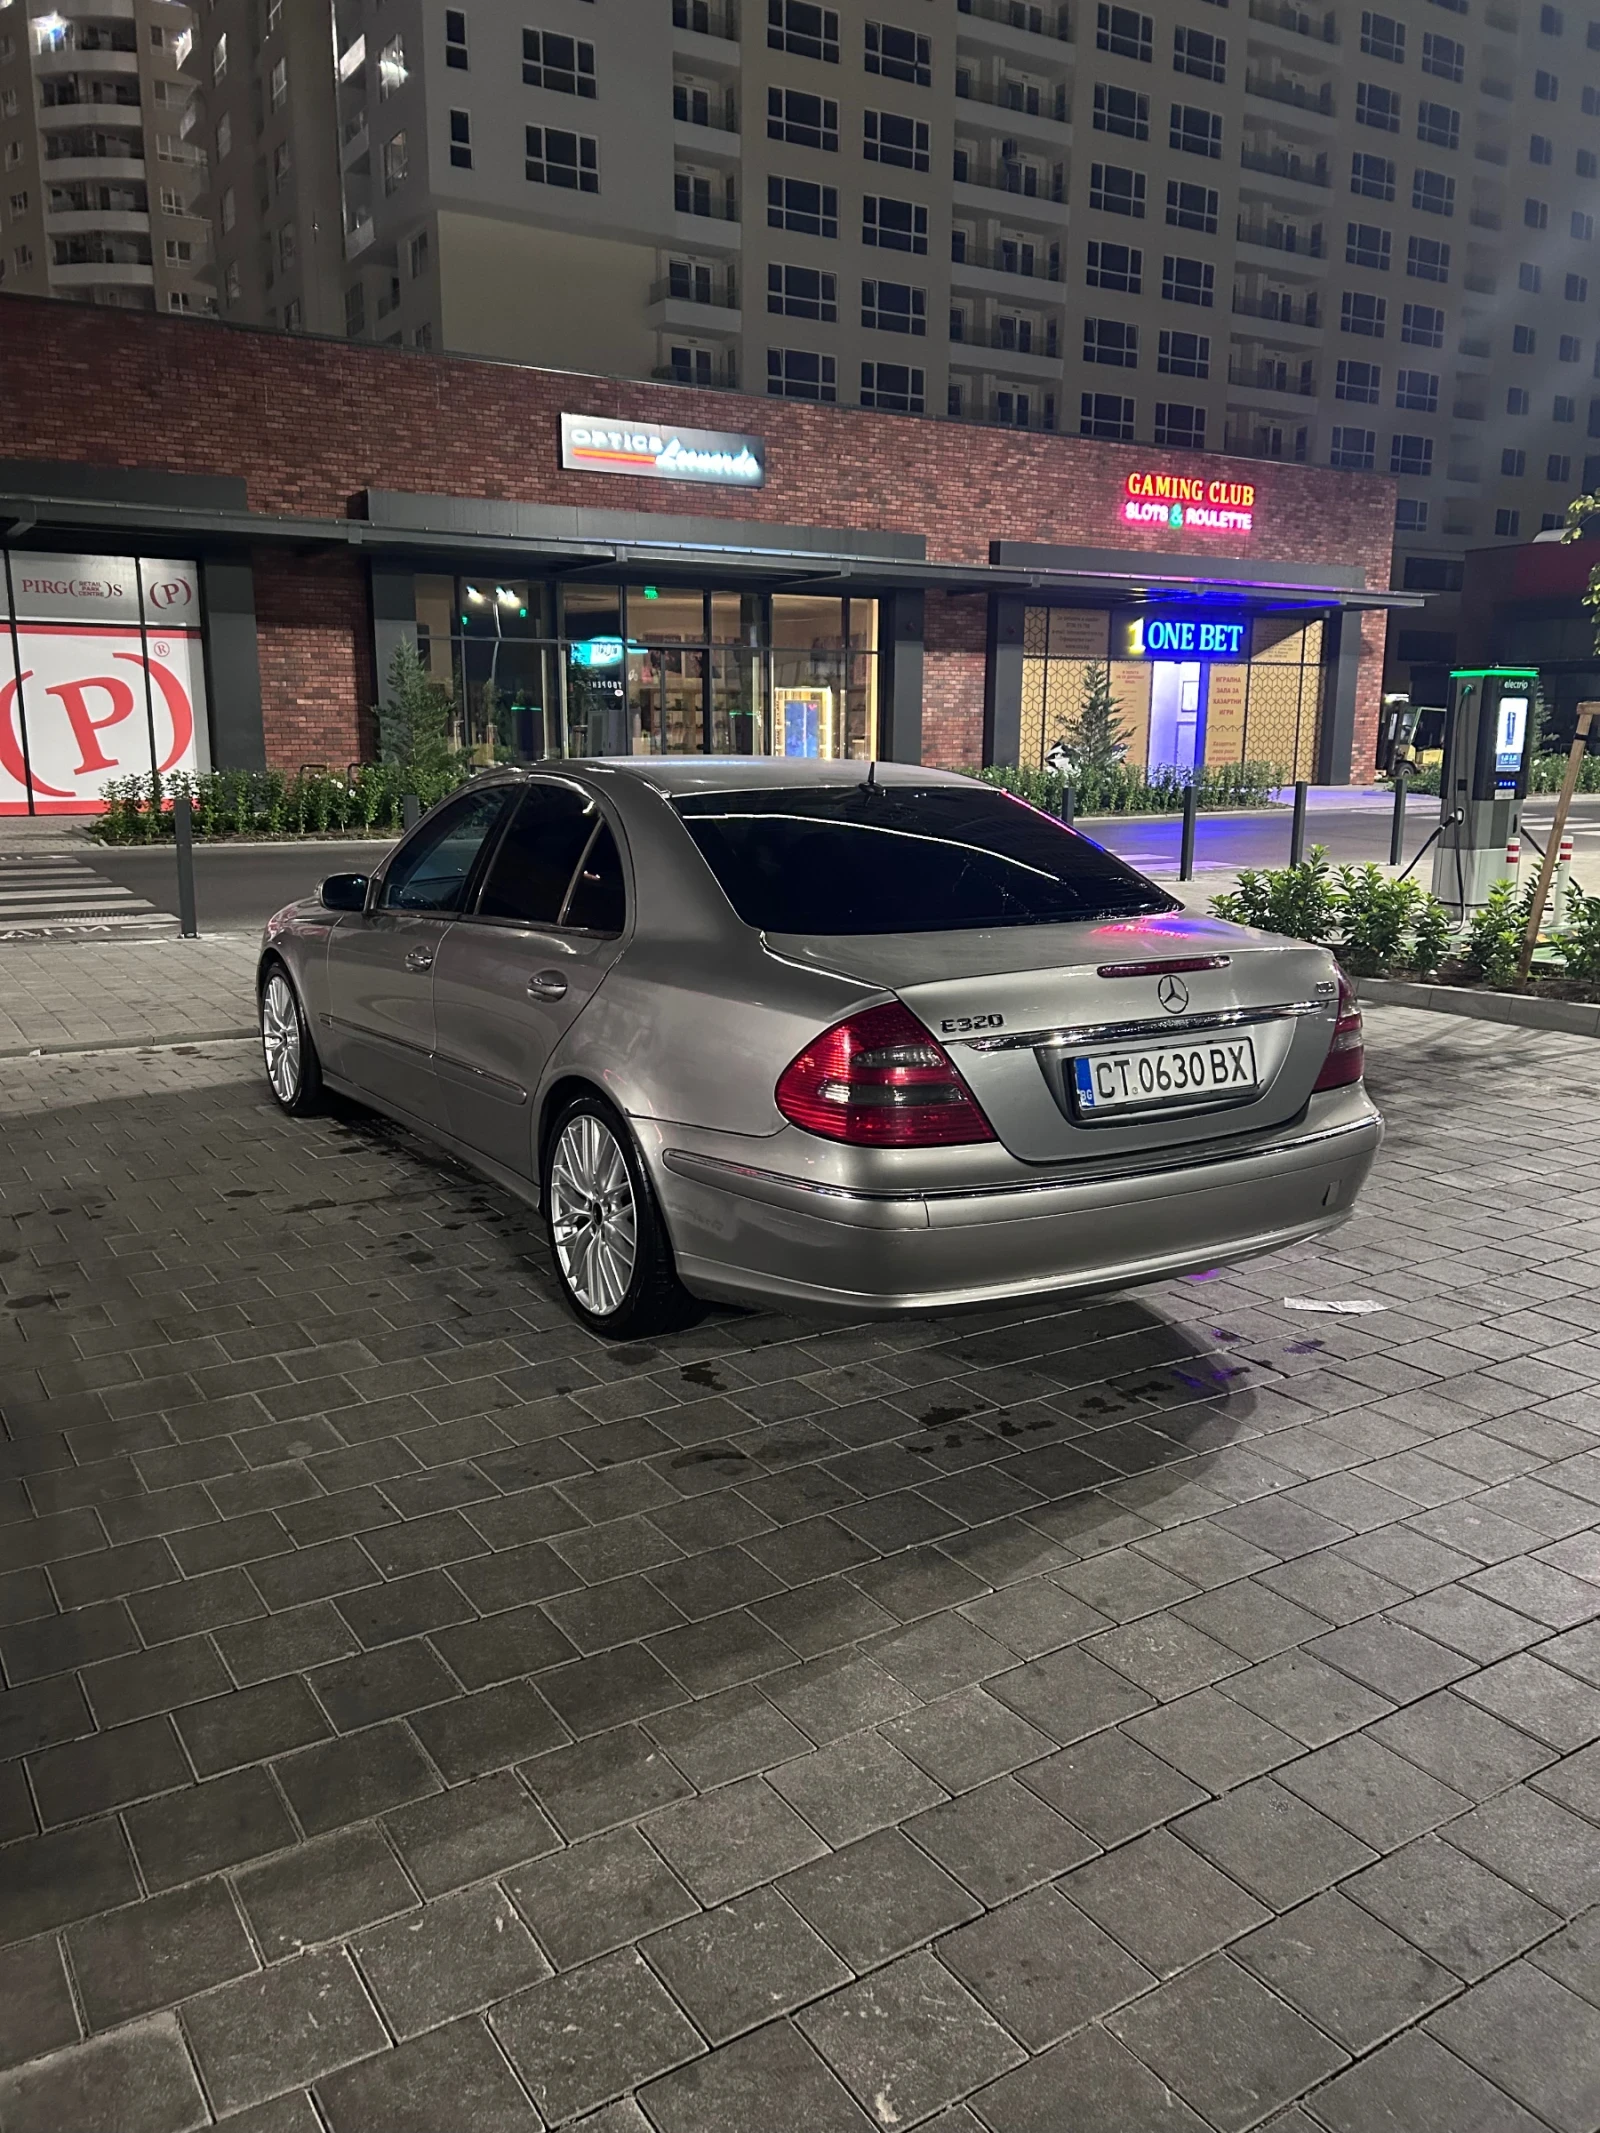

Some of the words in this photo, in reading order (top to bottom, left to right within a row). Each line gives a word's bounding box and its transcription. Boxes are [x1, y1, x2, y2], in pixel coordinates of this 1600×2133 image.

[570, 428, 663, 452] OPTICS
[1128, 473, 1203, 501] GAMING
[1208, 481, 1255, 506] CLUB
[1125, 502, 1169, 522] SLOTS
[1169, 503, 1184, 527] &
[1186, 507, 1253, 530] ROULETTE
[1147, 621, 1195, 650] ONE
[1199, 624, 1243, 651] BET
[1504, 679, 1528, 690] electrip
[940, 1013, 1004, 1033] E320
[1096, 1059, 1131, 1099] CT
[1138, 1051, 1205, 1093] 0630
[1209, 1045, 1249, 1084] BX
[1080, 1089, 1093, 1101] BG
